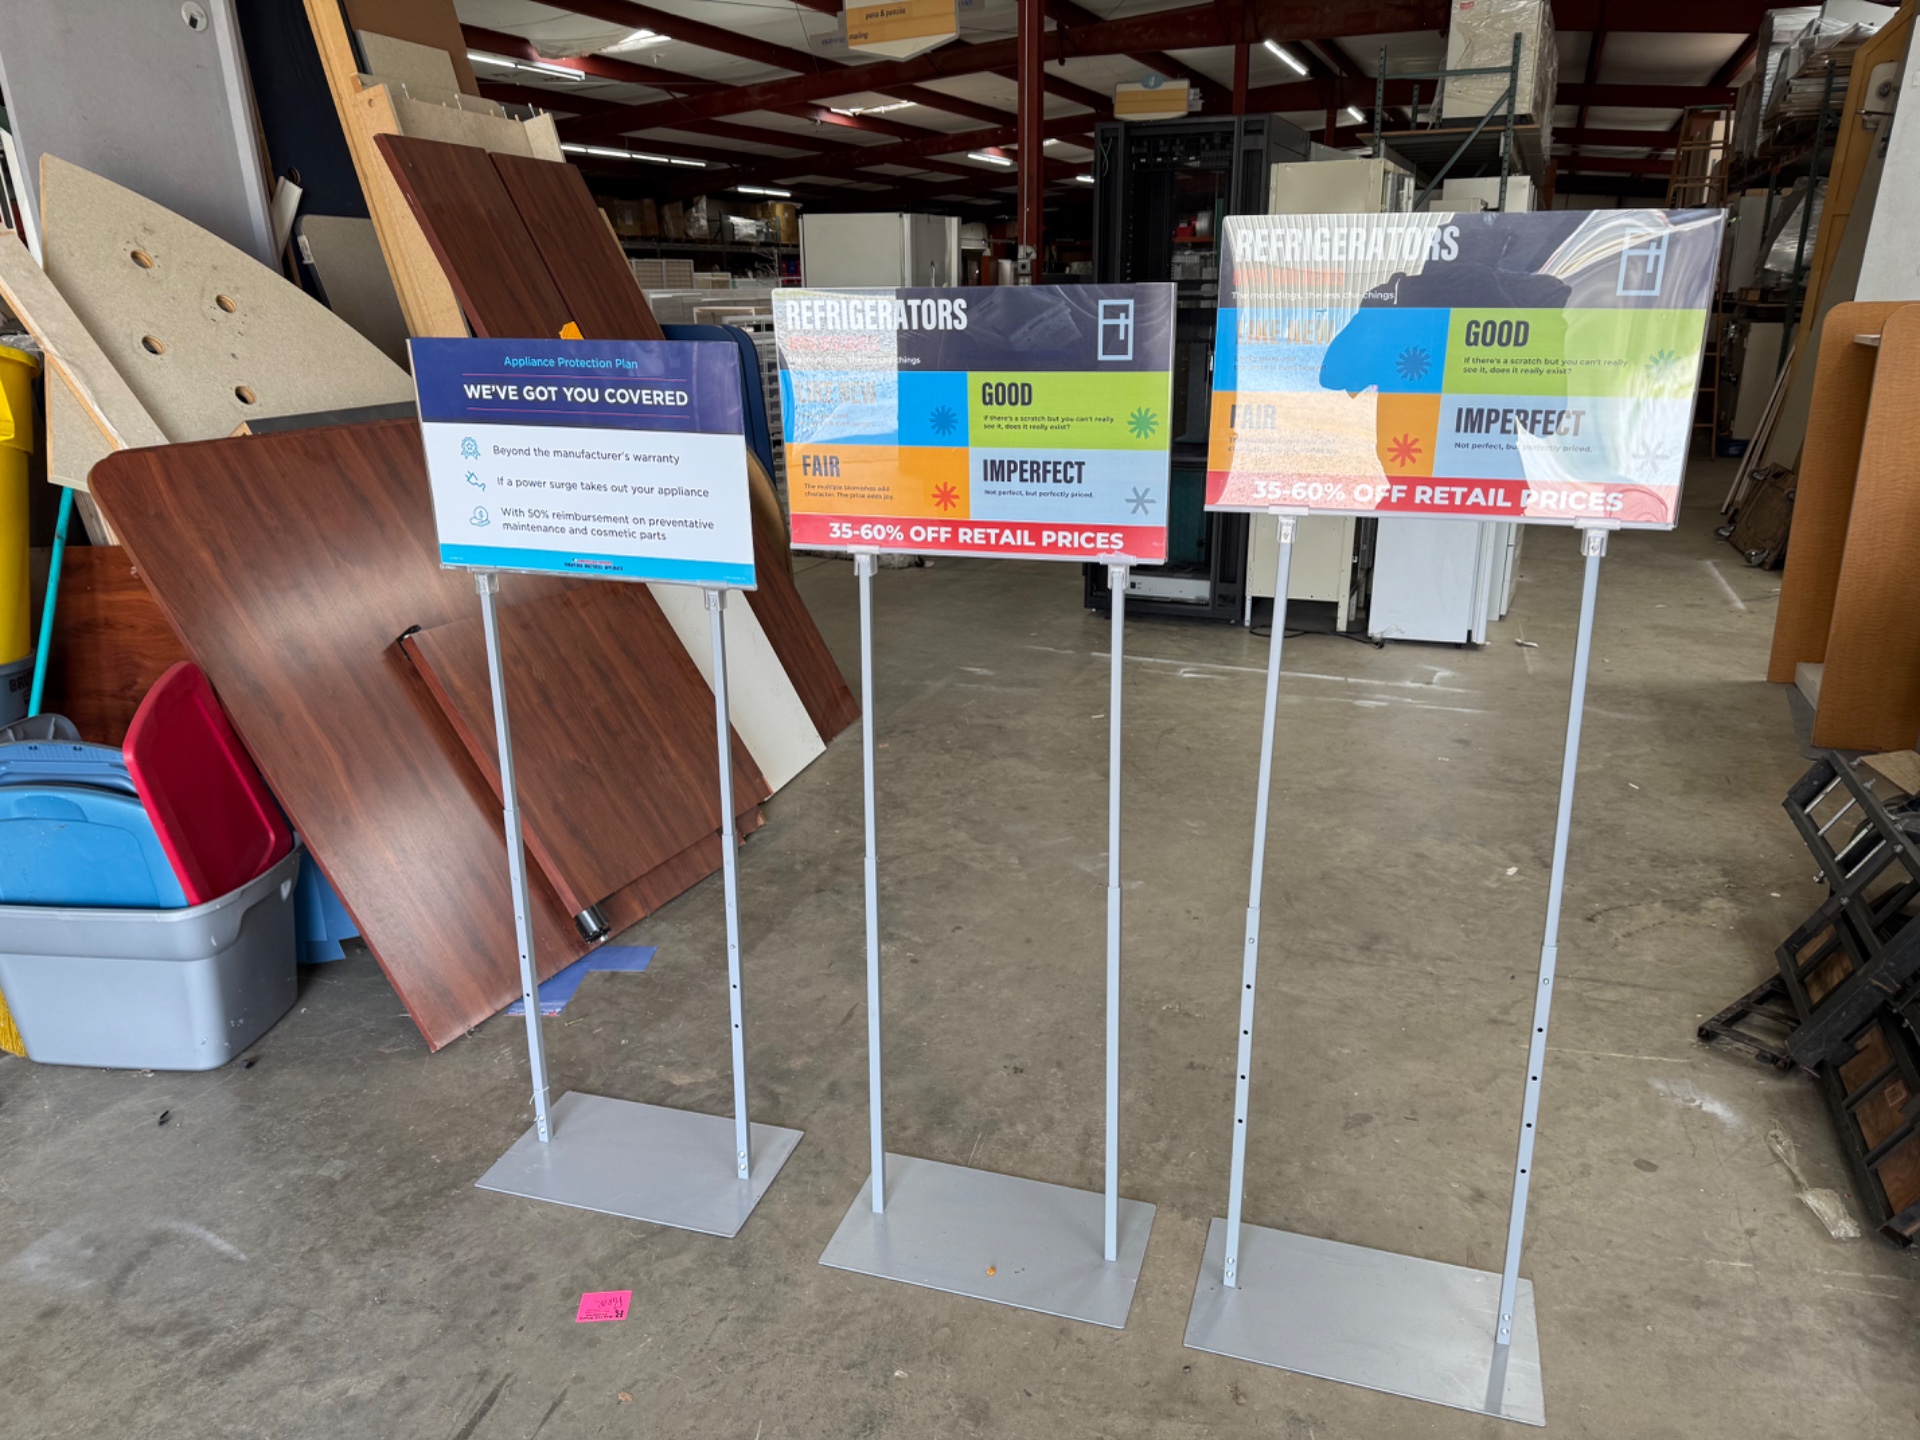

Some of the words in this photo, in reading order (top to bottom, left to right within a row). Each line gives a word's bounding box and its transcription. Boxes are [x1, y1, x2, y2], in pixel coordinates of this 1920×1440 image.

[1236, 225, 1460, 262] REFRIGERATORS
[1232, 291, 1249, 300] The
[1306, 291, 1320, 300] the
[786, 299, 968, 331] REFRIGERATORS
[1465, 320, 1530, 347] GOOD
[504, 357, 555, 368] Appliance
[558, 358, 612, 368] Protection
[616, 359, 638, 369] Plan
[1521, 367, 1544, 375] really
[1604, 359, 1628, 367] really
[464, 384, 519, 400] WE'VE
[523, 386, 558, 401] GOT
[563, 388, 599, 403] YOU
[605, 389, 688, 406] COVERED
[797, 380, 833, 404] LIKE
[839, 380, 877, 404] NEW
[982, 382, 1033, 407] GOOD
[1095, 416, 1114, 424] really
[1230, 404, 1277, 430] FAIR
[1455, 407, 1586, 436] IMPERFECT
[493, 445, 531, 458] Beyond
[534, 447, 550, 457] the
[553, 449, 630, 461] manufacturer's
[633, 454, 680, 465] warranty
[1472, 442, 1504, 451] perfect,
[1563, 445, 1593, 453] priced.
[803, 455, 840, 478] FAIR
[983, 459, 1086, 484] IMPERFECT
[498, 476, 505, 486] If
[507, 479, 513, 487] a
[516, 479, 546, 490] power
[550, 480, 578, 492] surge
[581, 481, 608, 492] takes
[611, 484, 628, 494] out
[631, 486, 654, 496] your
[658, 487, 710, 498] appliance
[837, 491, 849, 499] The
[850, 492, 865, 500] price
[999, 489, 1024, 497] perfect,
[1039, 490, 1069, 499] perfectly
[1253, 481, 1345, 501] 35-60%
[1354, 483, 1407, 504] OFF
[1415, 485, 1512, 507] RETAIL
[1521, 489, 1624, 511] PRICES
[501, 508, 525, 518] With
[528, 509, 550, 520] 50%
[552, 510, 629, 525] reimbursement
[633, 516, 646, 525] on
[649, 517, 715, 531] preventative
[503, 522, 566, 534] maintenance
[569, 524, 588, 536] and
[591, 526, 637, 539] cosmetic
[640, 530, 667, 541] parts
[829, 522, 904, 541] 35-60%
[910, 526, 952, 543] OFF
[958, 528, 1036, 547] RETAIL
[1042, 532, 1124, 550] PRICES
